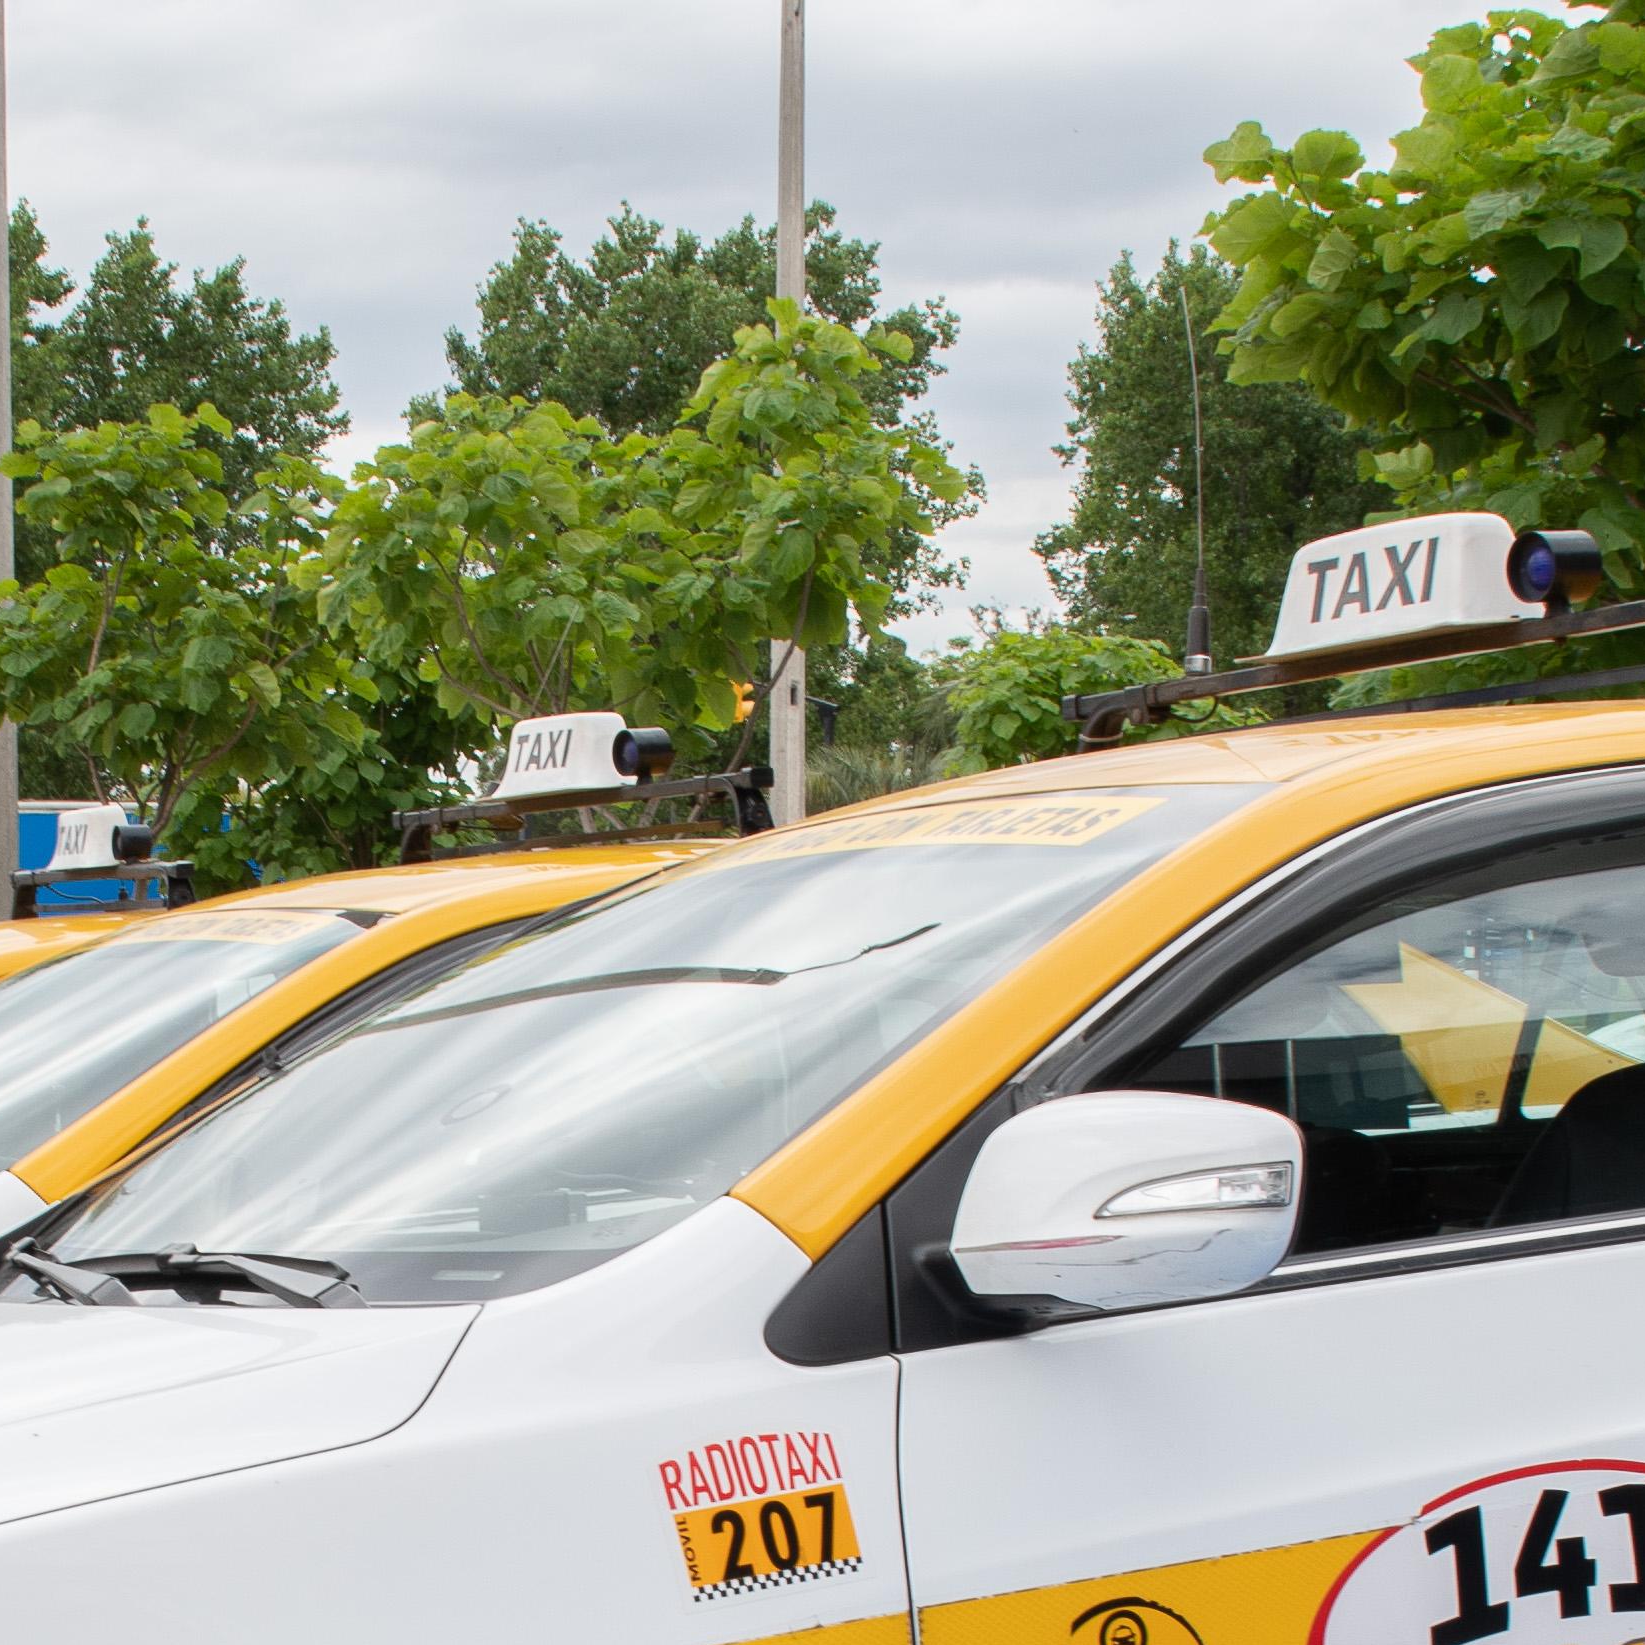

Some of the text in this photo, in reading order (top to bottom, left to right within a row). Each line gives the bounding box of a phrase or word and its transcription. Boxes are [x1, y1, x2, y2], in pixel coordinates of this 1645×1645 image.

[1307, 536, 1440, 624] TAXI
[514, 728, 573, 773] TAXI
[920, 807, 1122, 837] TARJETAS
[658, 1431, 843, 1510] RADIOTAXI
[710, 1491, 835, 1582] 207
